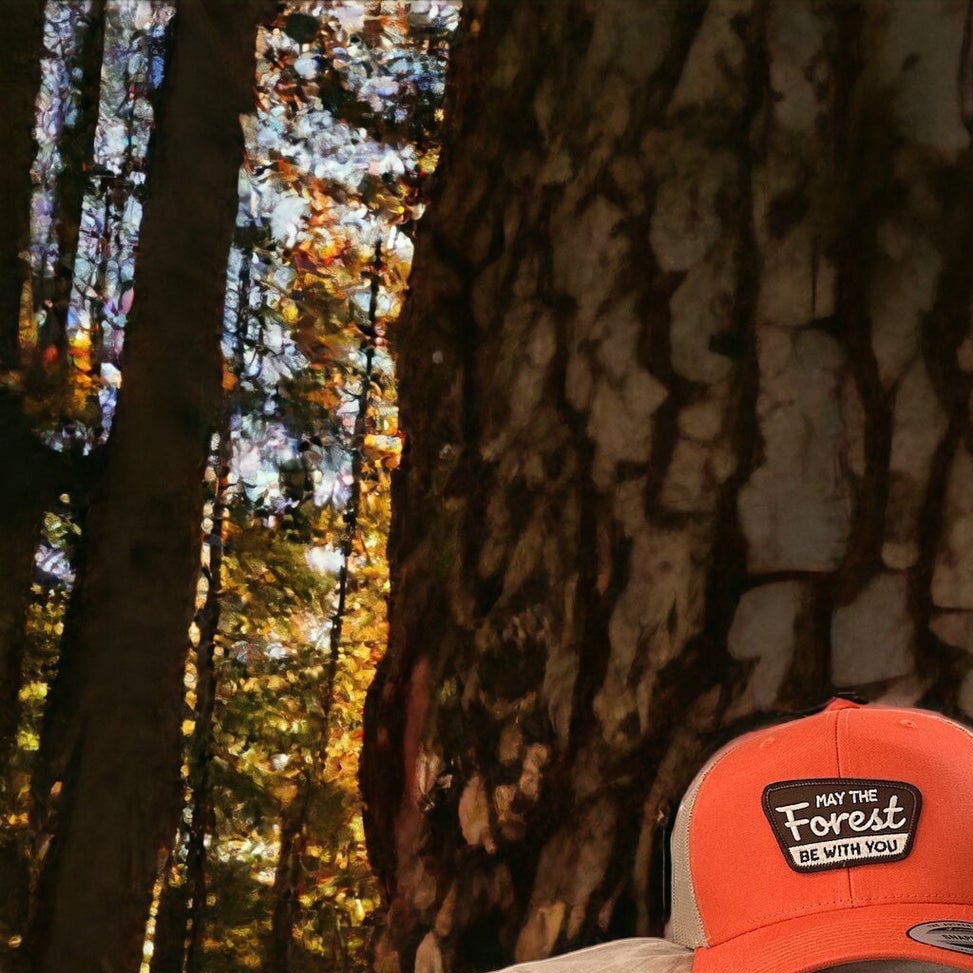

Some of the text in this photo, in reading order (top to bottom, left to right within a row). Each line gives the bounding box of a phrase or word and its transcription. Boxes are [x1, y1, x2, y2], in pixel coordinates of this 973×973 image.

[816, 788, 878, 808] MAY THE
[775, 795, 906, 842] Forest
[799, 839, 898, 863] BE WITH YOU
